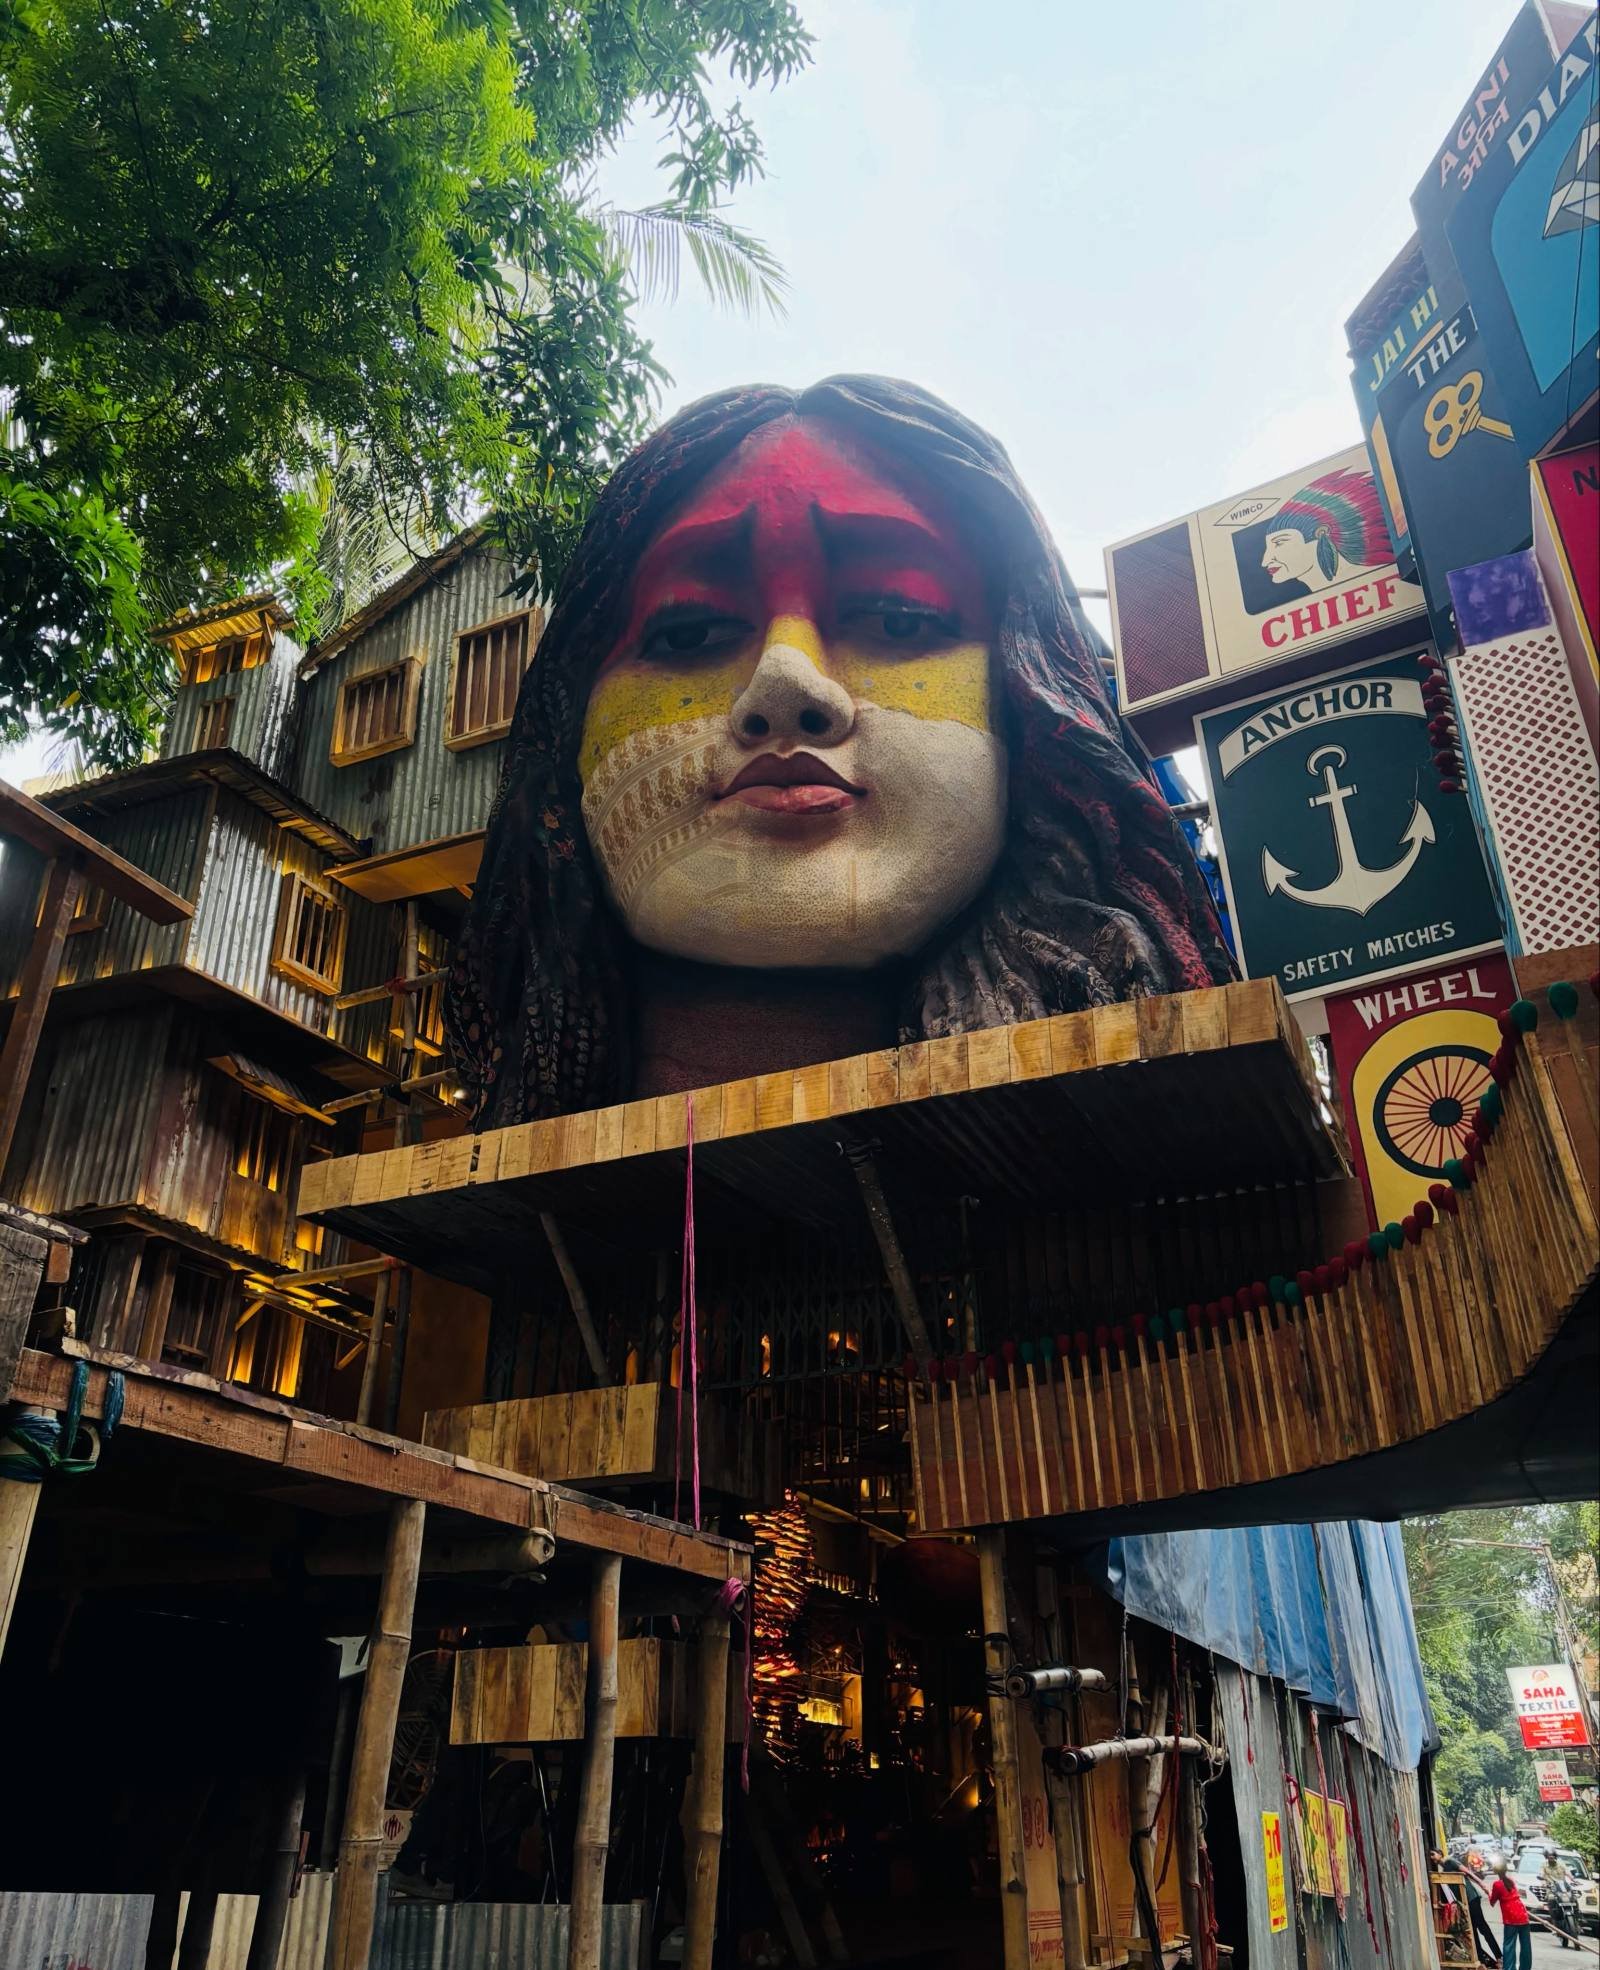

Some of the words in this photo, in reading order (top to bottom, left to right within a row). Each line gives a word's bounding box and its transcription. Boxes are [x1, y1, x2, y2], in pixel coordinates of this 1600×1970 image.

[1440, 55, 1510, 189] AGNI
[1370, 325, 1407, 392] JAI
[1407, 318, 1467, 390] THE
[1230, 502, 1263, 521] WIMCO
[1261, 573, 1401, 648] CHIEF
[1241, 681, 1394, 754] ANCHOR
[1283, 947, 1354, 983] SAFETY
[1366, 921, 1456, 961] MATCHES
[1351, 967, 1498, 1033] WHEEL
[1519, 1699, 1577, 1713] TEXTILE
[1523, 1686, 1567, 1700] SAHA
